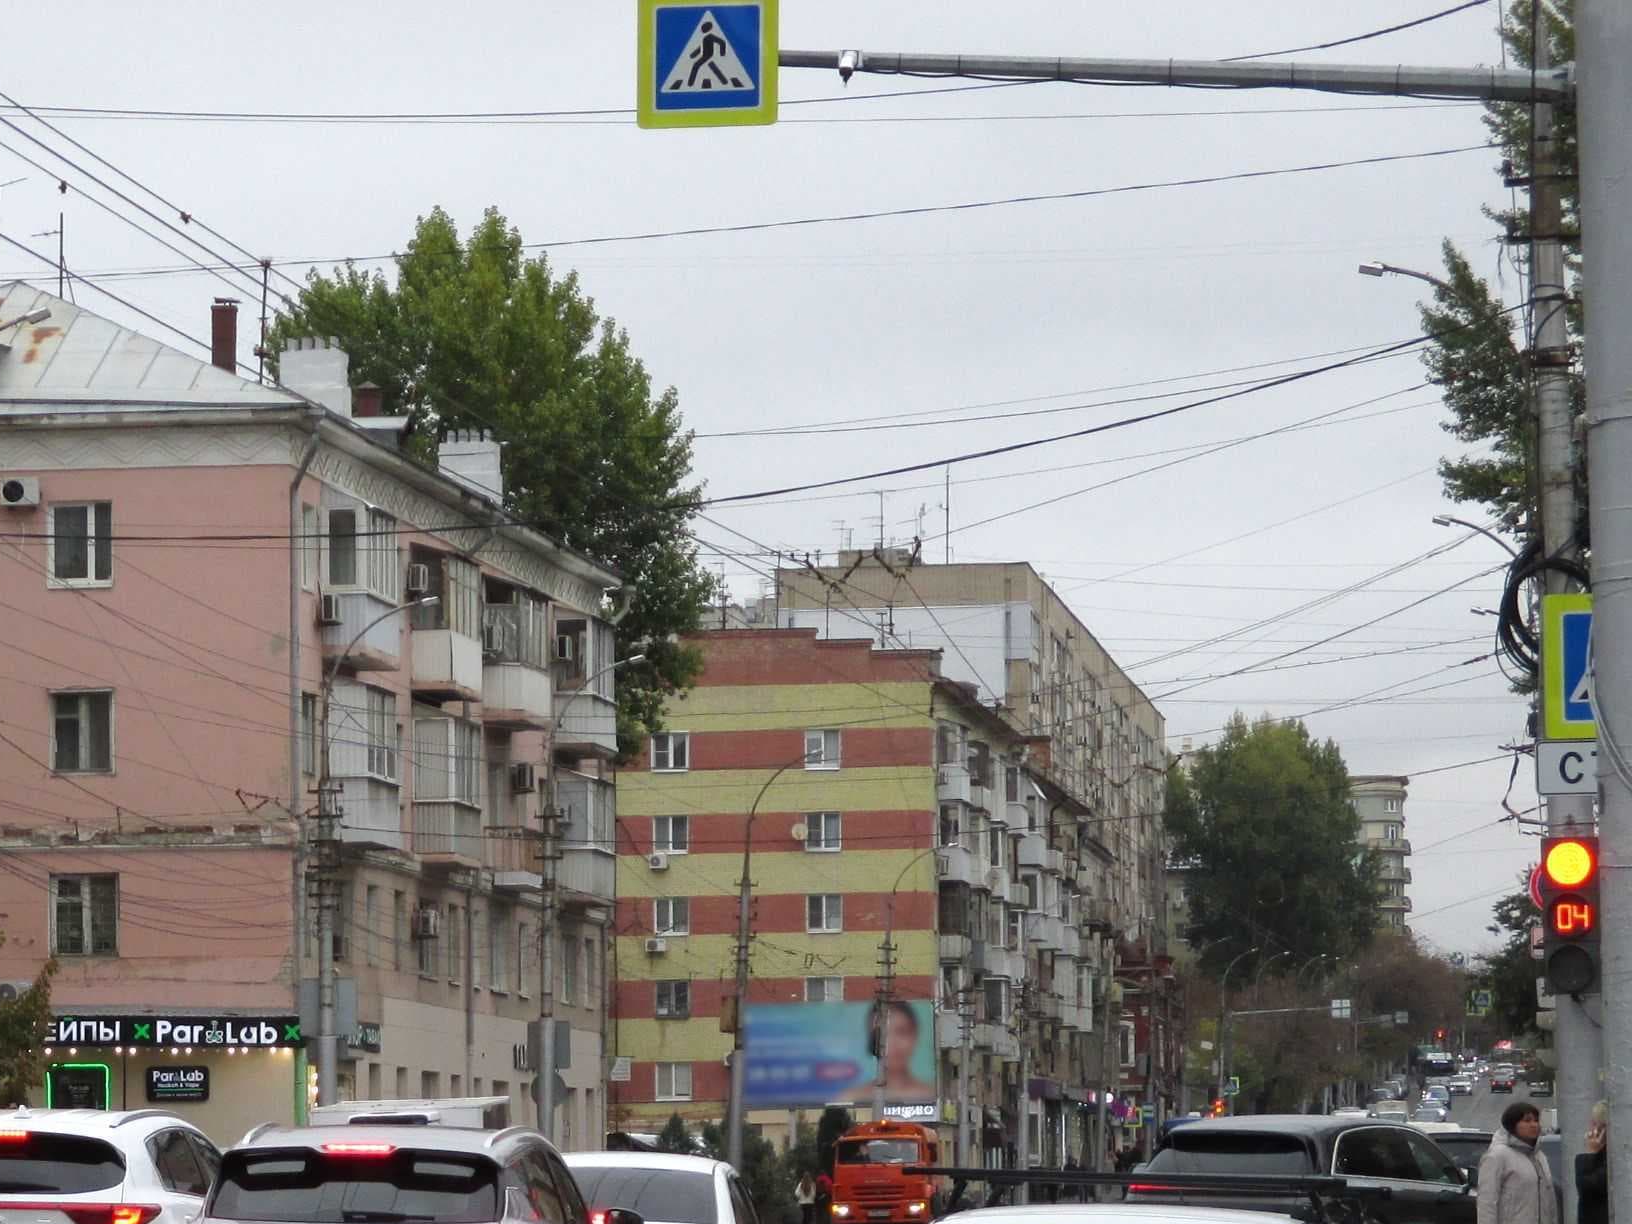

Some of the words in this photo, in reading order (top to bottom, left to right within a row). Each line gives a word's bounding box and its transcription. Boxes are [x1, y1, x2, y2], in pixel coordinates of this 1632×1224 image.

[1559, 750, 1598, 785] С
[1555, 903, 1590, 931] 04
[32, 1017, 121, 1042] ЕЙПЫ
